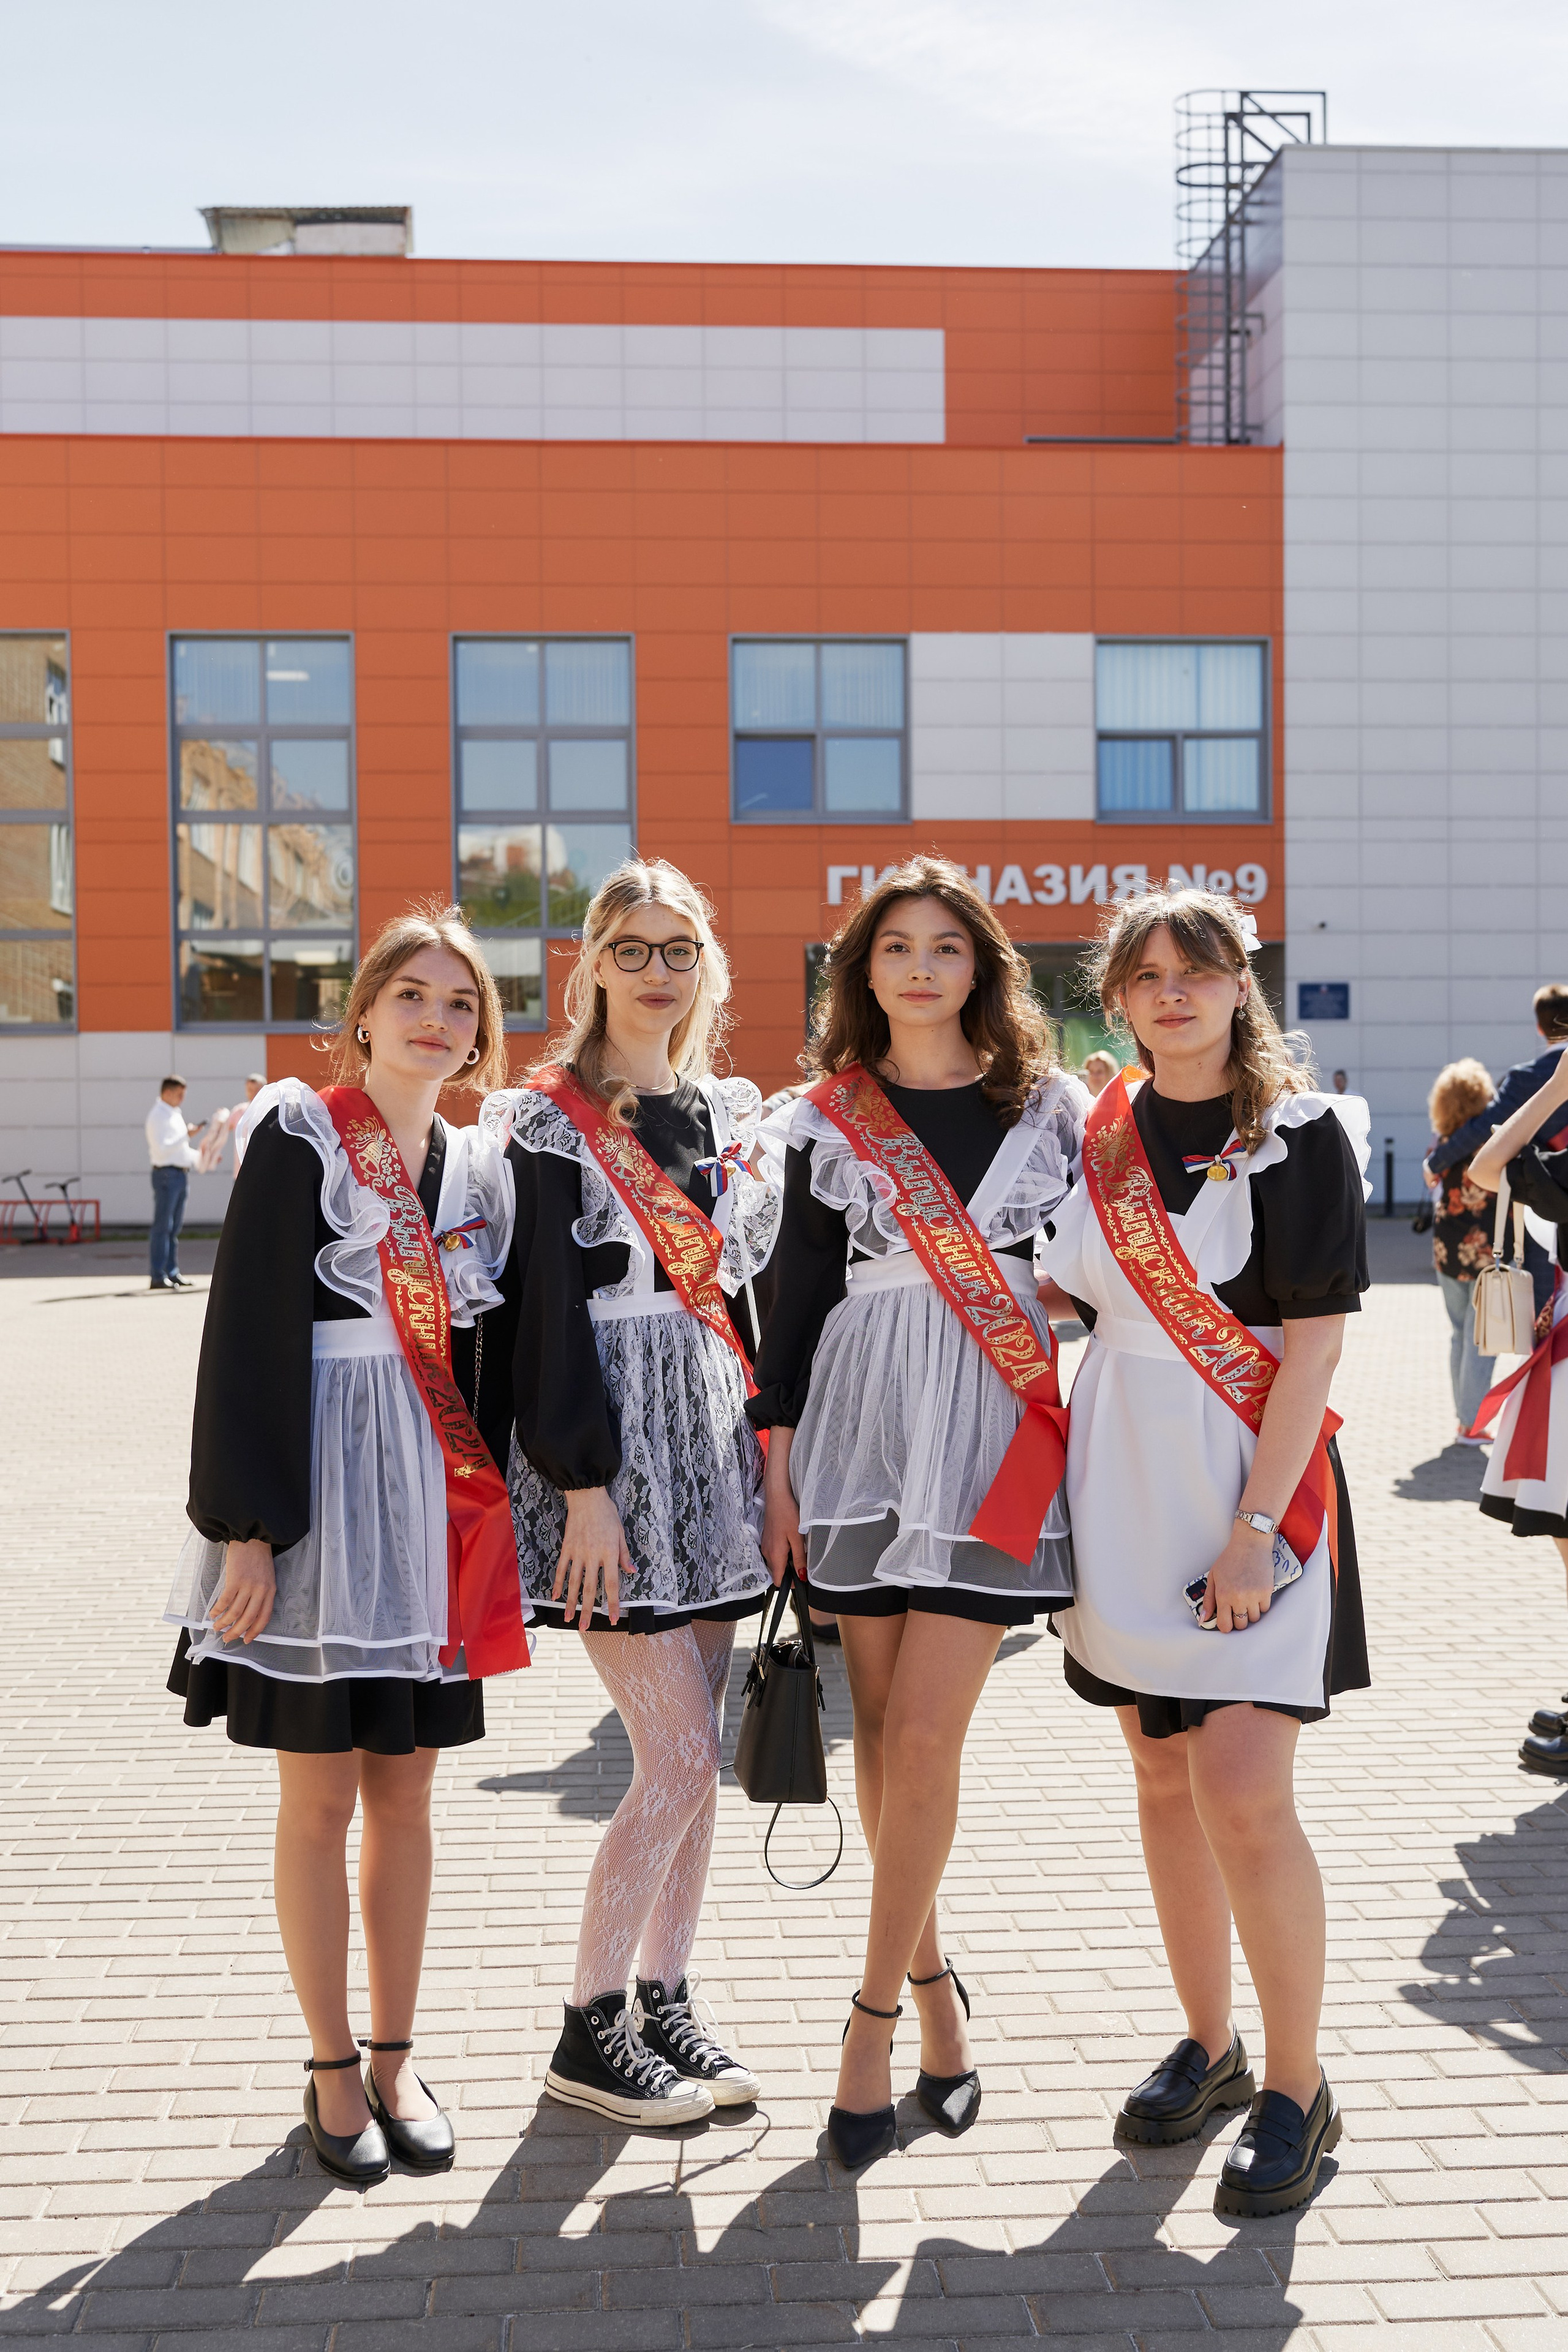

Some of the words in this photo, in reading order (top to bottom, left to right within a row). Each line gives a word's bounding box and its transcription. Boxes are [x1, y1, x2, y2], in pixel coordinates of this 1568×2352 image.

[827, 864, 1147, 905] ГИНАЗИЯ
[866, 1125, 990, 1302] Выпускник
[963, 1294, 1050, 1390] 2024
[1104, 1166, 1216, 1340] Выпускник
[426, 1381, 492, 1479] 2024
